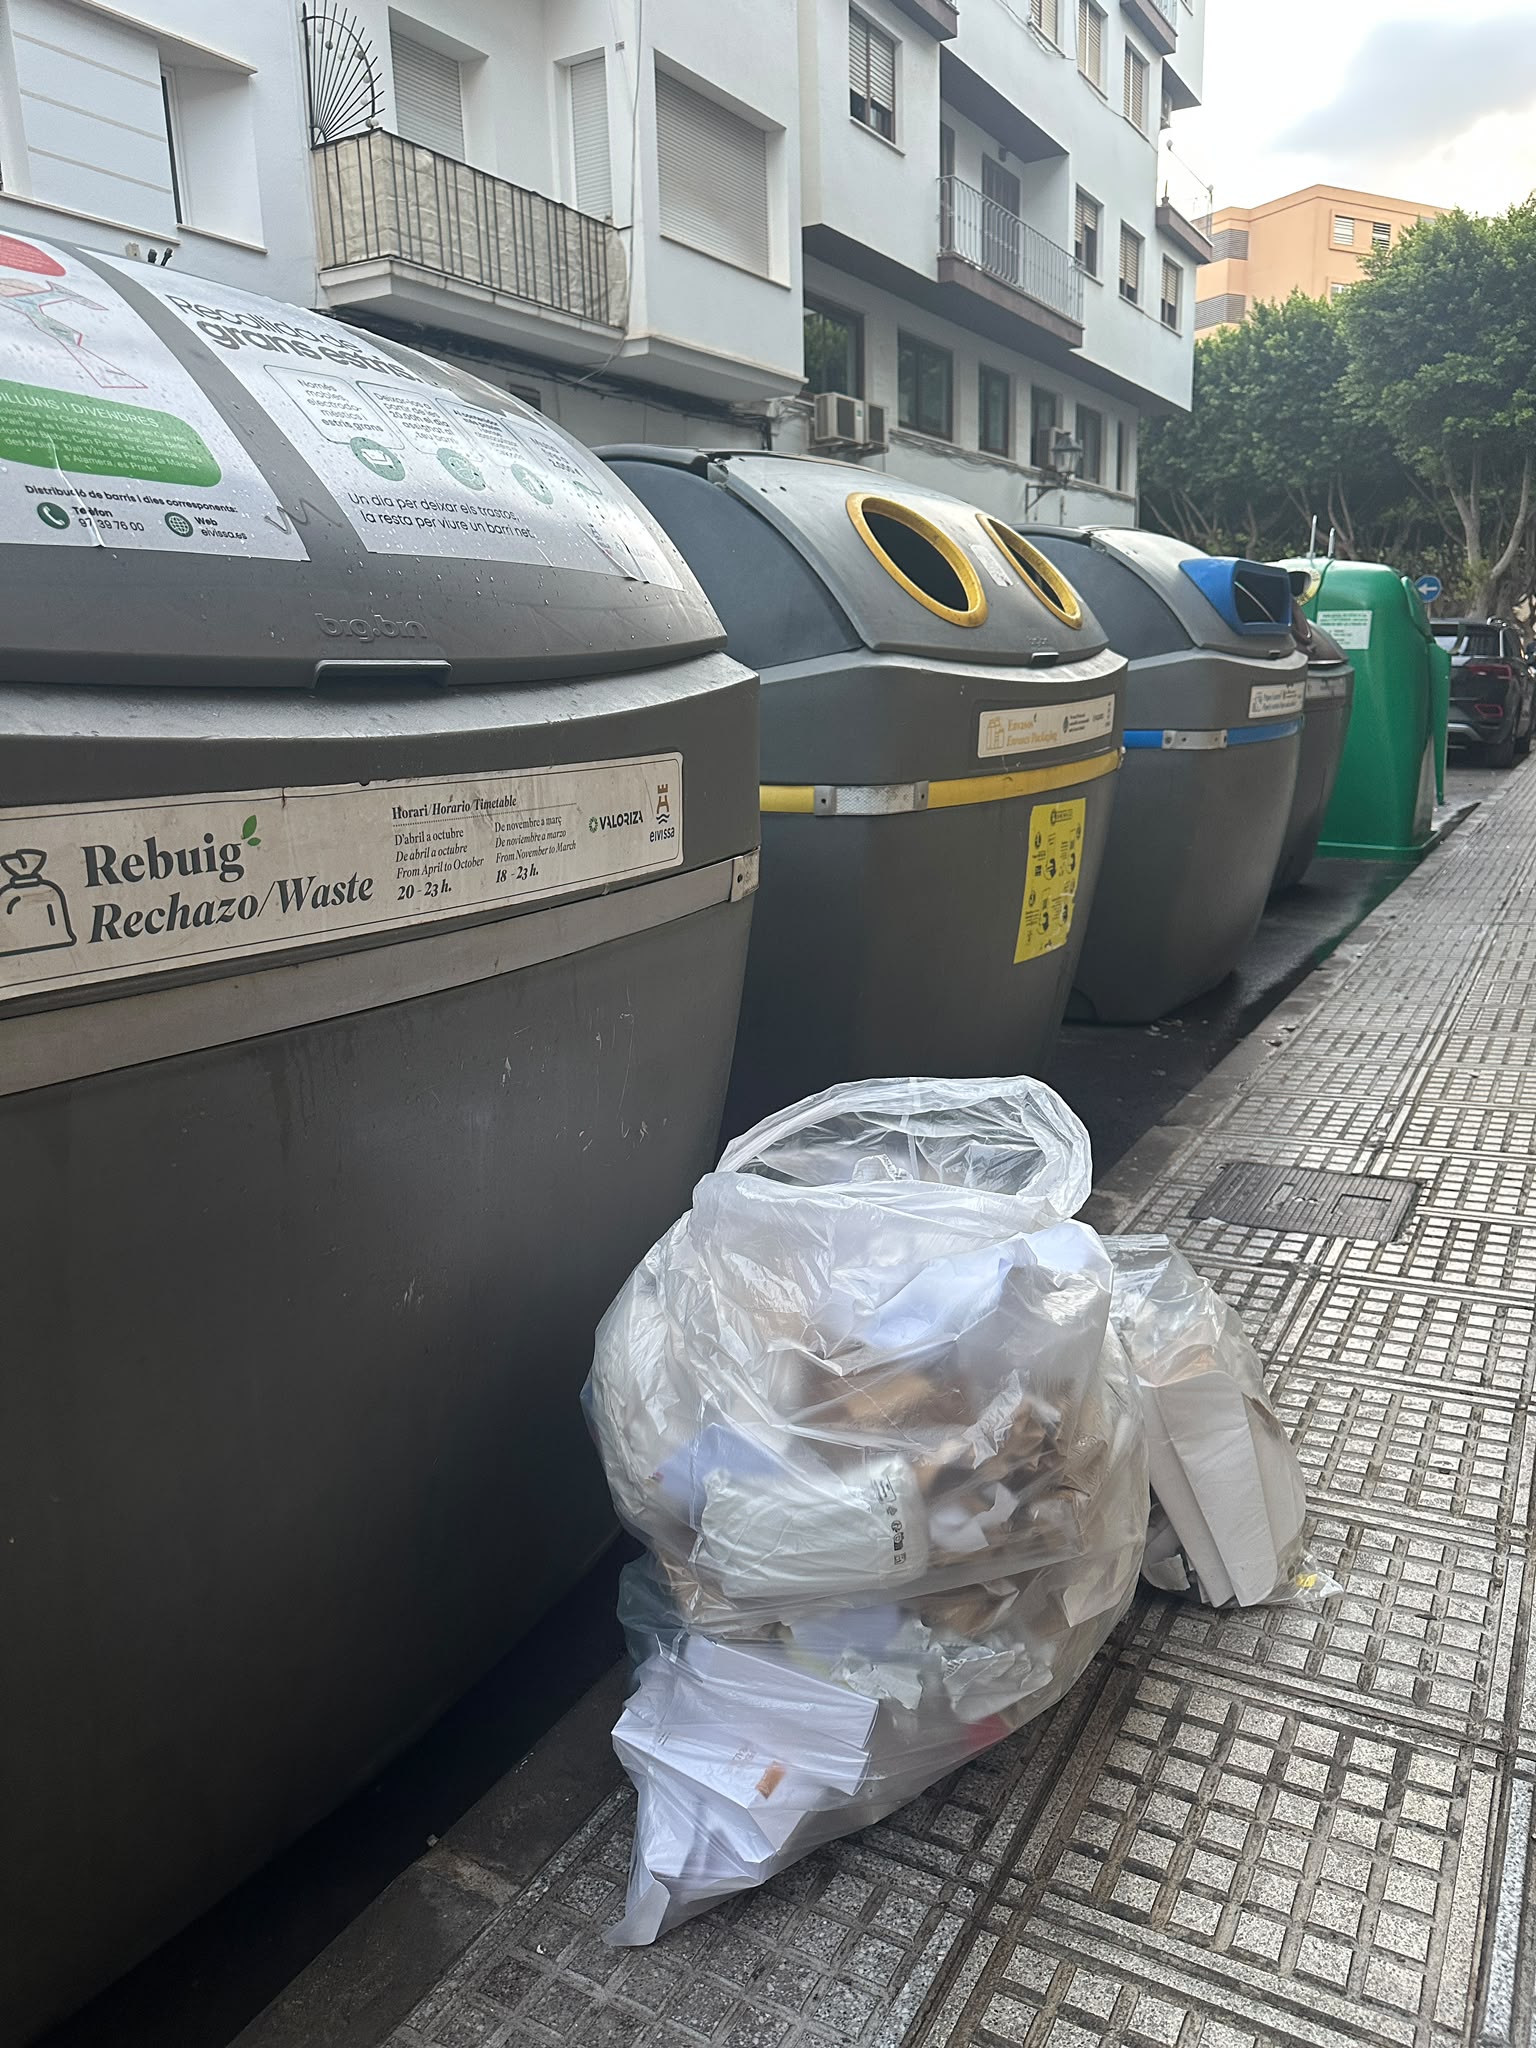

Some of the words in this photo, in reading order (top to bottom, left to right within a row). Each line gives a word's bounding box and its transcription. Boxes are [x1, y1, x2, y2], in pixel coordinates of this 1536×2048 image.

[165, 294, 322, 343] Recollida
[320, 333, 363, 353] de
[198, 321, 323, 360] grans
[71, 403, 159, 428] DIVENDRES
[353, 423, 384, 432] grans
[72, 506, 113, 518] Teèfon
[88, 490, 103, 499] de
[104, 490, 137, 503] barris
[143, 494, 165, 505] dies
[166, 498, 238, 513] corresponents:
[348, 492, 369, 505] Un
[371, 493, 395, 507] dia
[396, 498, 418, 511] per
[420, 498, 458, 513] deixar
[460, 503, 476, 515] els
[478, 506, 520, 522] trastos,
[78, 517, 95, 528] 97
[97, 519, 113, 530] 39
[113, 520, 129, 531] 76
[129, 522, 145, 533] 00
[194, 516, 218, 527] Web
[360, 510, 375, 523] la
[379, 514, 413, 526] resta
[416, 517, 437, 529] per
[439, 518, 468, 531] viure
[470, 521, 485, 532] un
[487, 521, 513, 535] barri
[201, 527, 248, 540] eivissa.es
[495, 821, 507, 834] De
[507, 817, 541, 831] novembre
[545, 815, 563, 829] març
[599, 810, 644, 831] VALORIZA
[394, 832, 425, 846] D'abril
[425, 834, 431, 842] a
[433, 828, 464, 842] octubre
[495, 836, 508, 849] De
[508, 831, 541, 845] noviembre
[547, 829, 567, 841] marzo
[80, 832, 245, 887] Rebuig
[395, 850, 408, 863] De
[408, 846, 429, 862] abril
[430, 850, 437, 858] a
[437, 843, 468, 858] octubre
[496, 851, 515, 864] From
[515, 846, 549, 861] November
[548, 845, 556, 856] to
[555, 840, 576, 854] March
[396, 866, 421, 880] From
[421, 861, 445, 877] April
[445, 862, 452, 873] to
[453, 855, 484, 871] October
[495, 868, 507, 884] 18
[516, 866, 529, 882] 23
[529, 863, 540, 879] h.
[397, 885, 414, 901] 20
[424, 882, 439, 898] 23
[440, 879, 453, 895] h.
[87, 872, 374, 944] Rechazo/Waste
